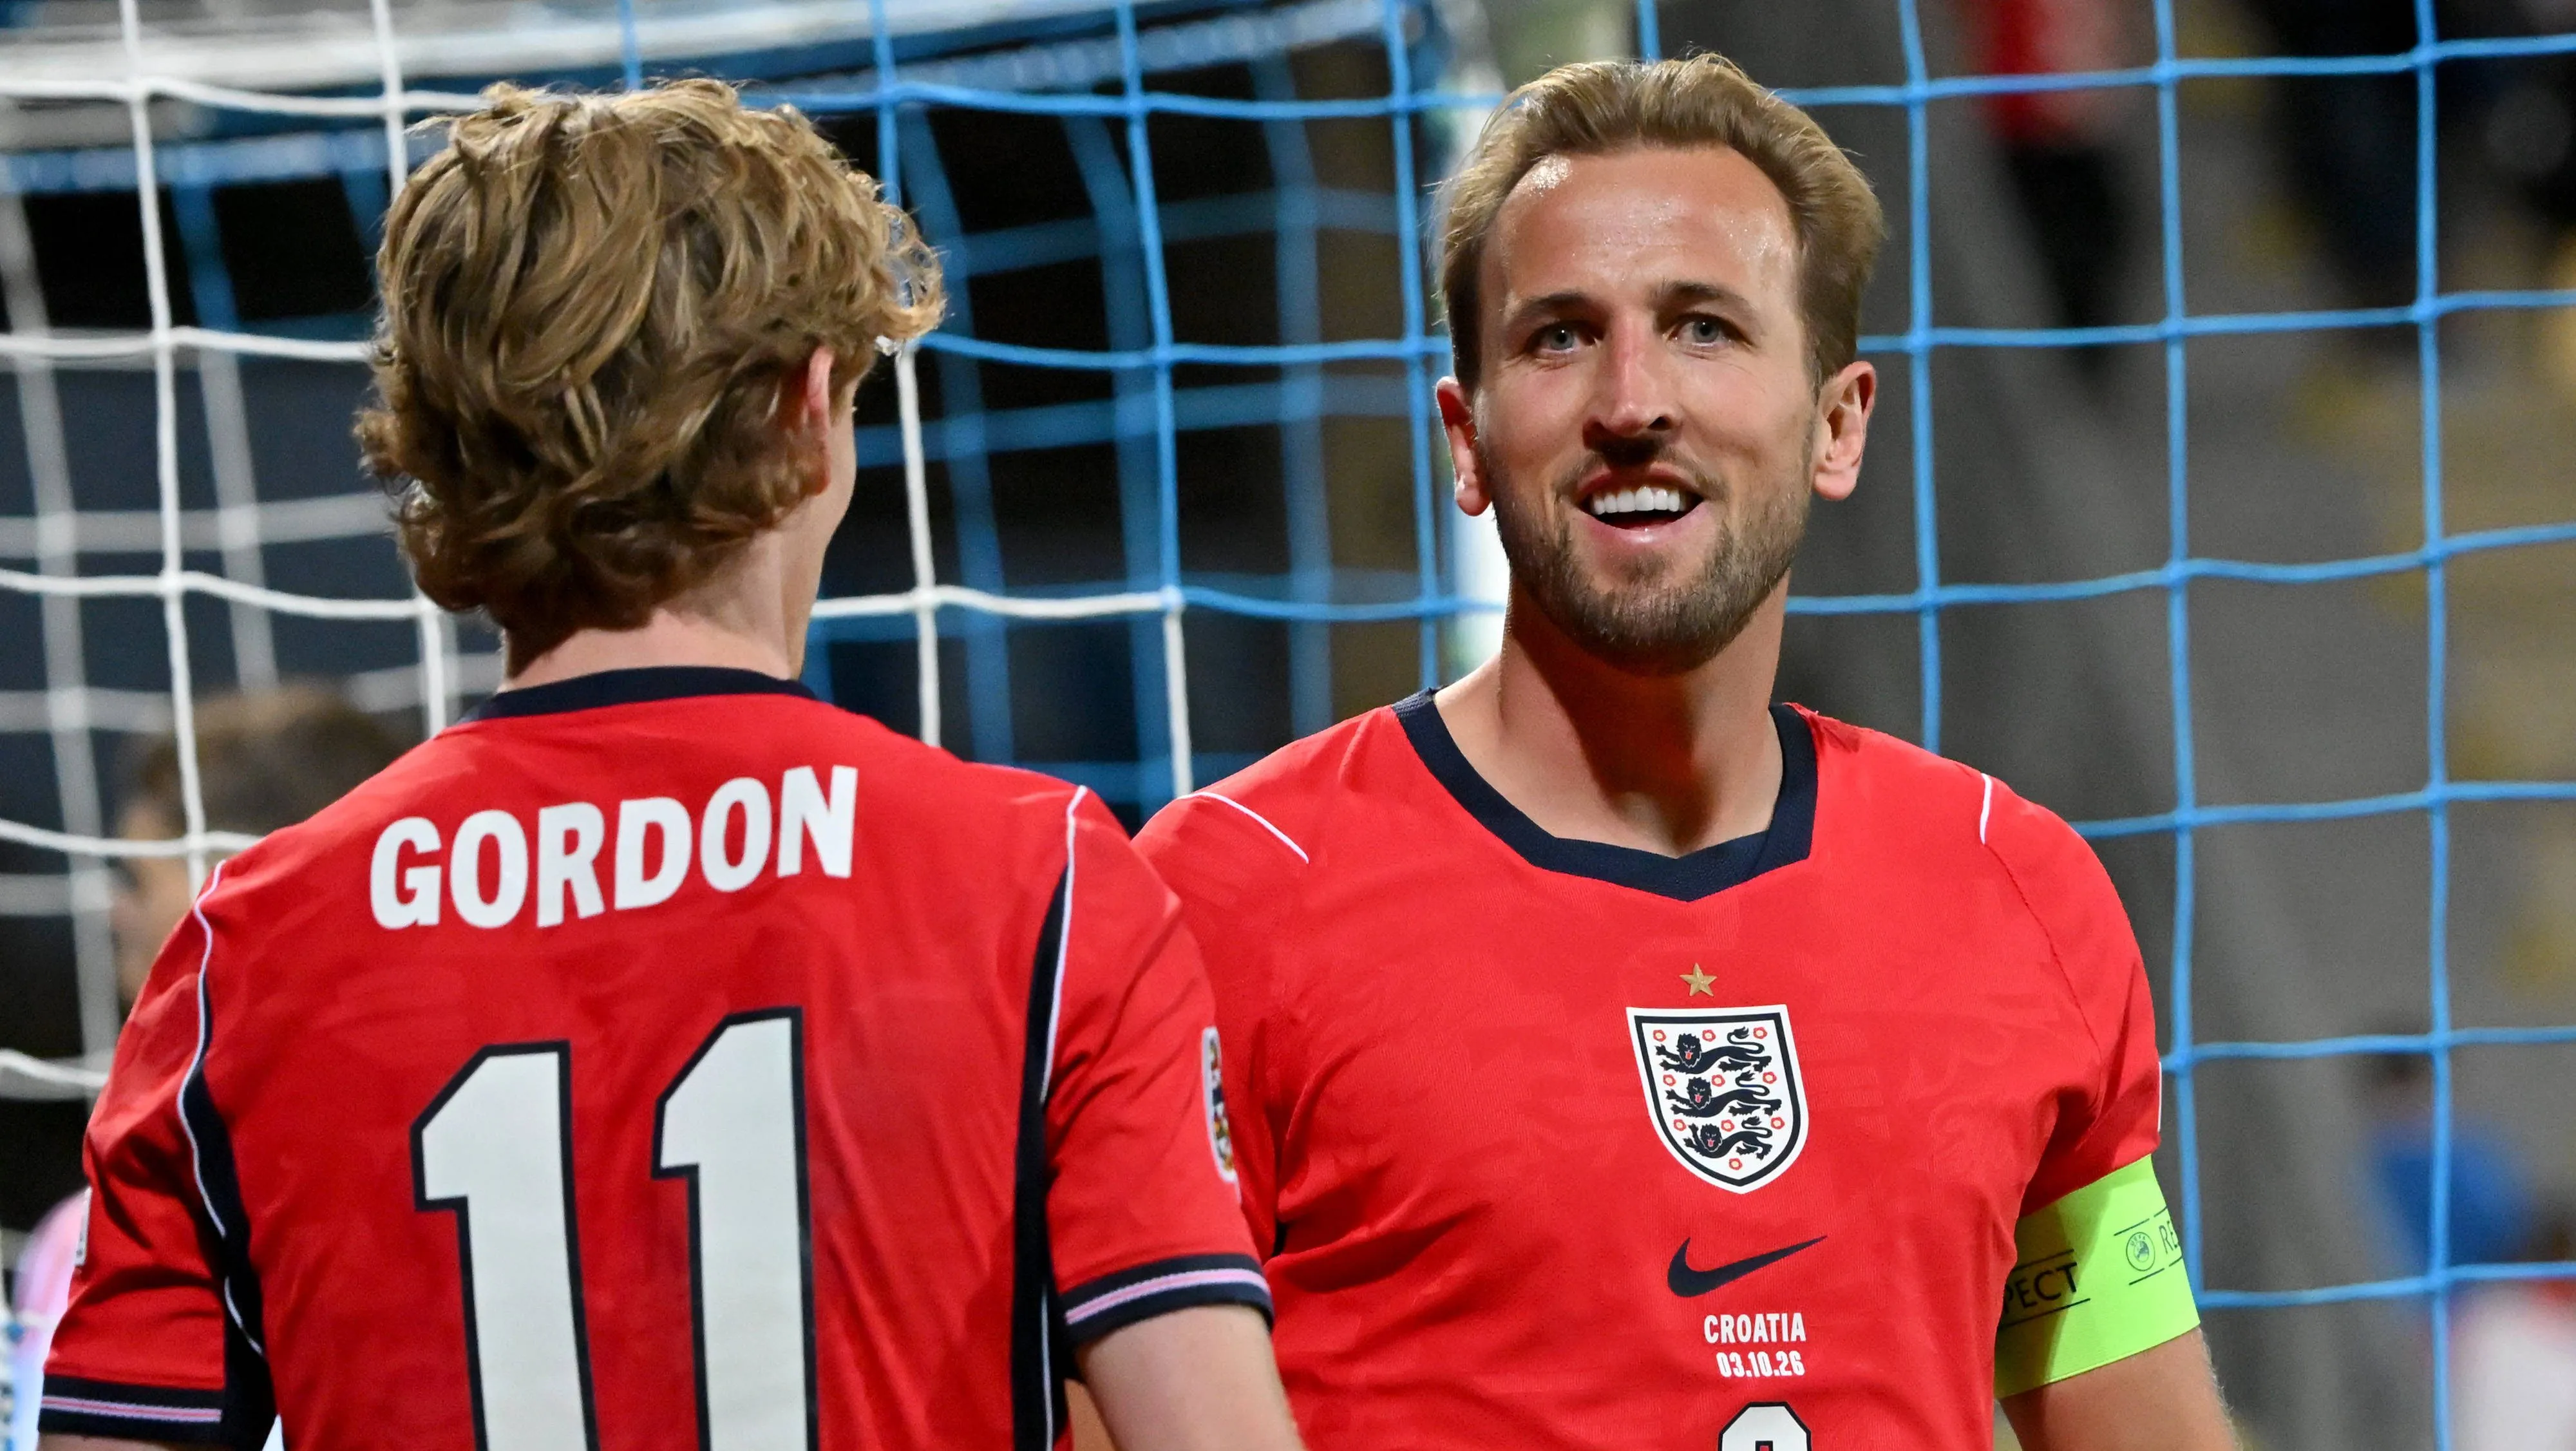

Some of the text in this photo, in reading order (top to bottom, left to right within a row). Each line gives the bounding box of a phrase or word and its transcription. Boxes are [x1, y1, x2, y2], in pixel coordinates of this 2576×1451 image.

[370, 764, 858, 930] GORDON
[409, 1005, 820, 1451] 11
[1703, 1313, 1807, 1343] CROATIA
[1716, 1350, 1806, 1378] 03.10.26
